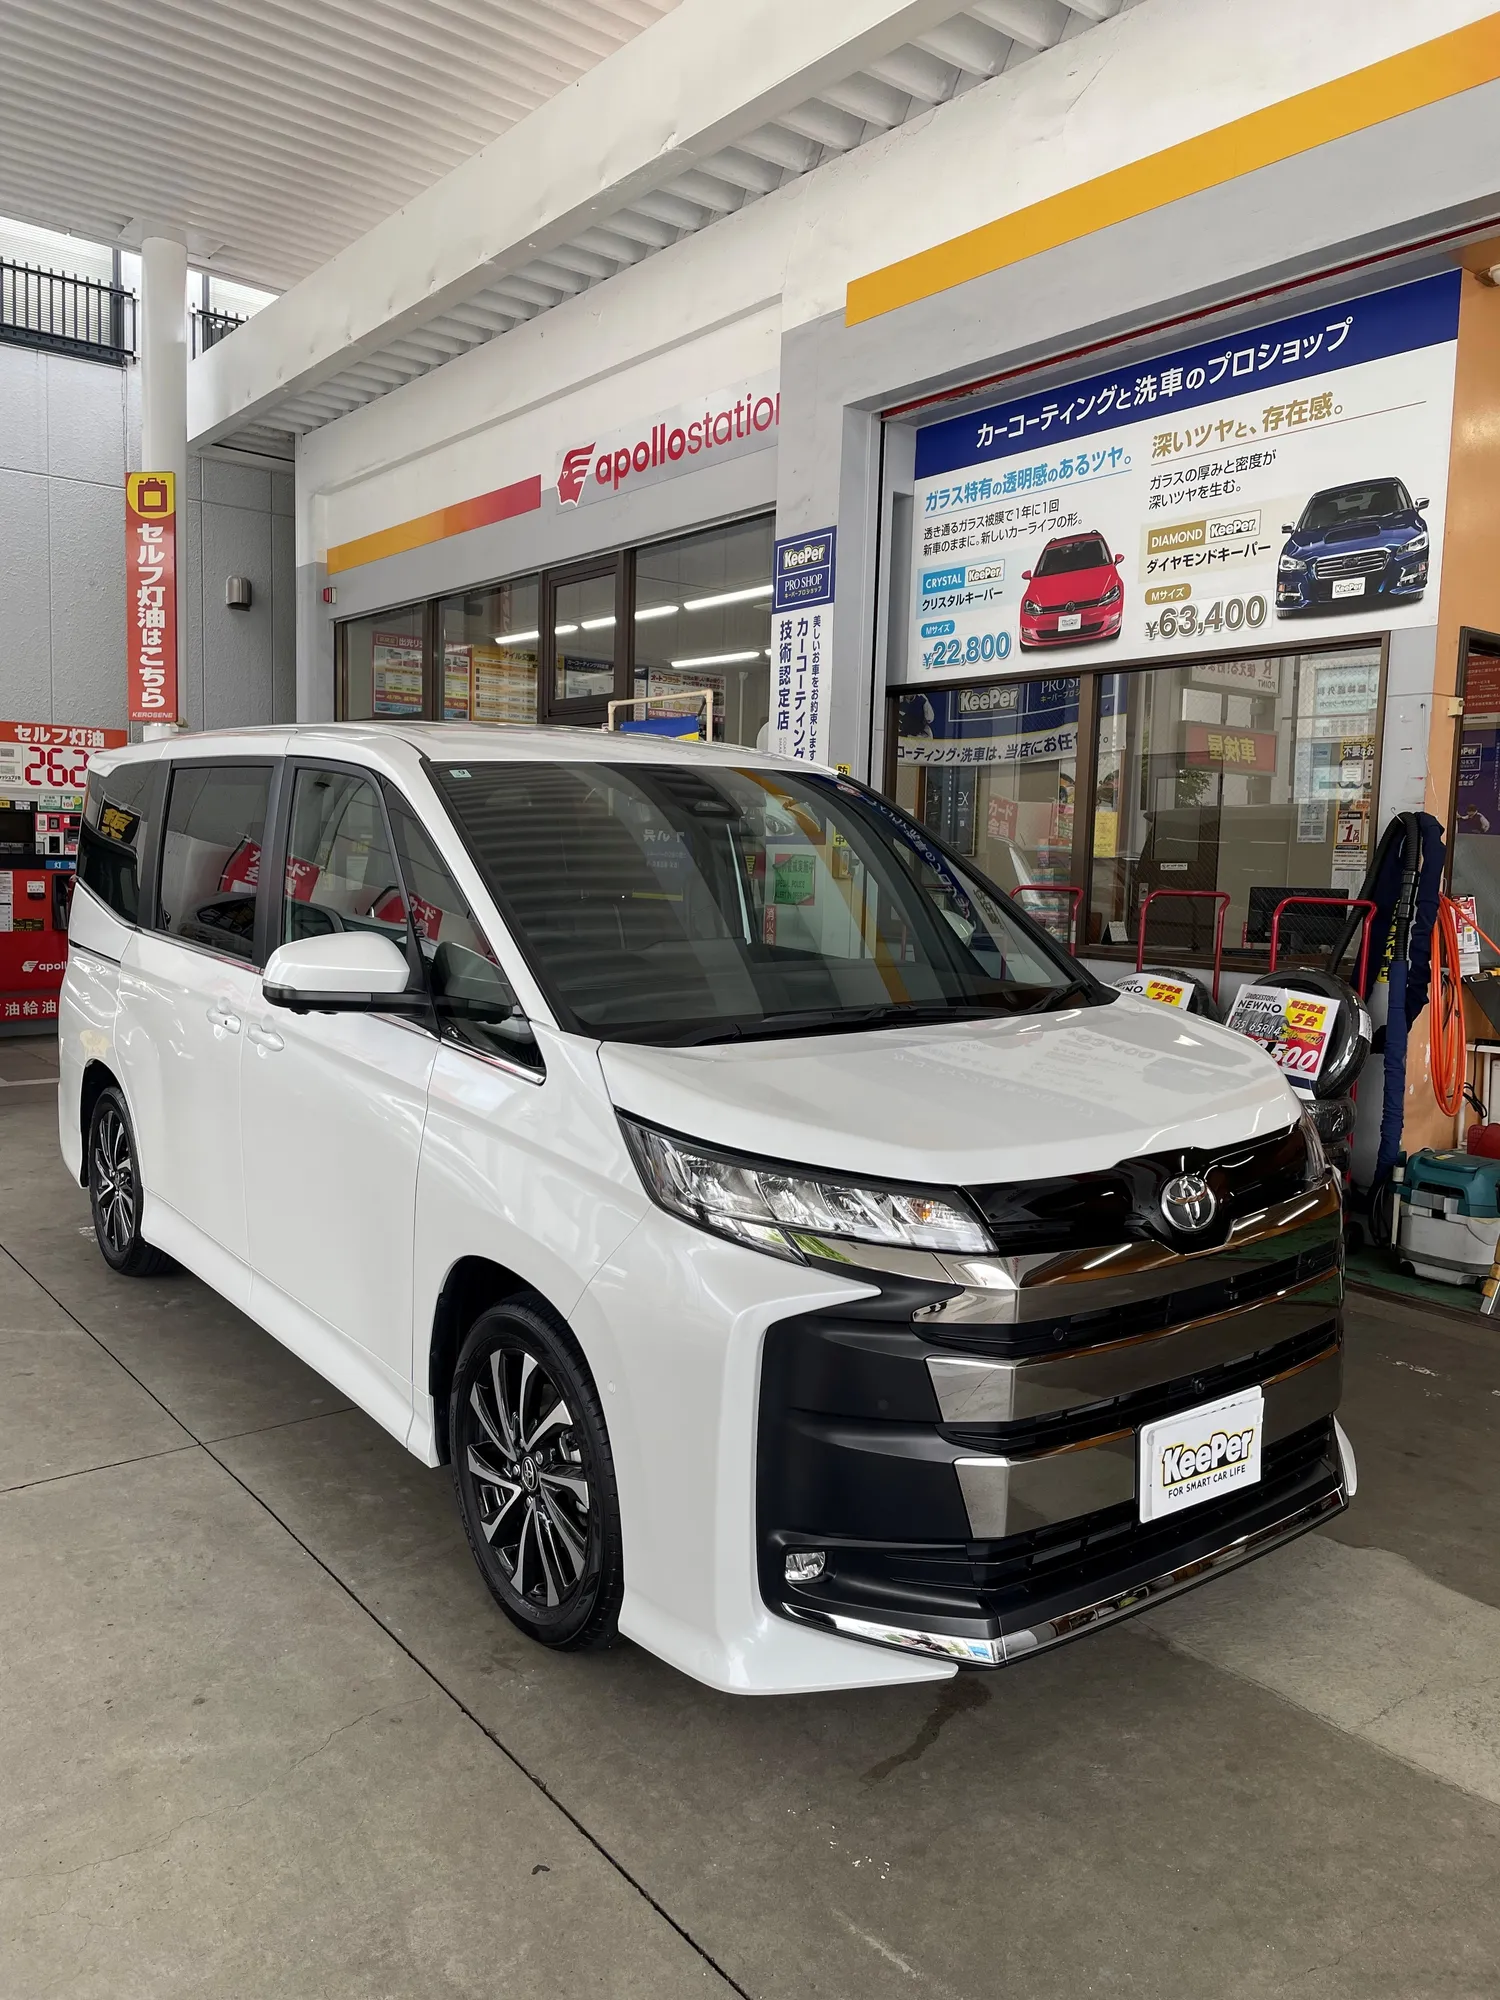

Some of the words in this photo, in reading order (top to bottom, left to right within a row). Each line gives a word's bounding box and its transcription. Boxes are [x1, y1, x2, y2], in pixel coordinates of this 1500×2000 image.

[975, 315, 1354, 448] カーコーティングと洗車のプロショップ
[595, 392, 781, 490] apollostatio
[1151, 391, 1343, 459] 深いツヤと、存在感。
[925, 446, 1132, 512] ガラス特有の透明感のあるツヤ。
[1149, 449, 1277, 491] ガラスの厚みと密度が
[1148, 480, 1242, 511] 深いツヤを生む。
[922, 512, 1083, 557] 新車のままに。新しいカーライフの形。
[1151, 528, 1203, 548] DIAMOND
[1209, 518, 1256, 539] KeePer
[783, 543, 826, 570] KeePer
[1146, 541, 1271, 575] ダイヤモンドキーパー
[784, 578, 800, 591] PRO
[801, 573, 823, 588] SHOP
[925, 572, 962, 589] CRYSTAL
[967, 566, 1002, 583] KeePer
[1334, 582, 1363, 595] KeePer
[922, 586, 1004, 612] クリスタルキーパー
[1151, 588, 1185, 602] Mサイズ
[136, 523, 166, 708] セルフ灯油はこちら
[925, 622, 951, 635] Mサイズ
[1145, 595, 1268, 640] ¥63,400
[922, 631, 1012, 669] ¥22,800
[777, 620, 792, 731] 技術認定店
[793, 617, 808, 759] カーコーティング
[809, 615, 821, 761] 美しいお車をお約束します
[1040, 678, 1066, 694] PRO
[131, 711, 174, 719] KEROSENE
[958, 687, 1020, 713] KeePer
[14, 724, 105, 748] セルフ灯油
[25, 746, 106, 788] 262
[0, 999, 57, 1016] 油給油
[1237, 1000, 1282, 1013] NEWNO
[1291, 1013, 1319, 1028] 5台
[1161, 1428, 1255, 1488] KeePer
[1168, 1486, 1184, 1499] FOR
[1186, 1475, 1212, 1493] SMART
[1213, 1469, 1228, 1483] CAR
[1229, 1463, 1247, 1478] LIFE
